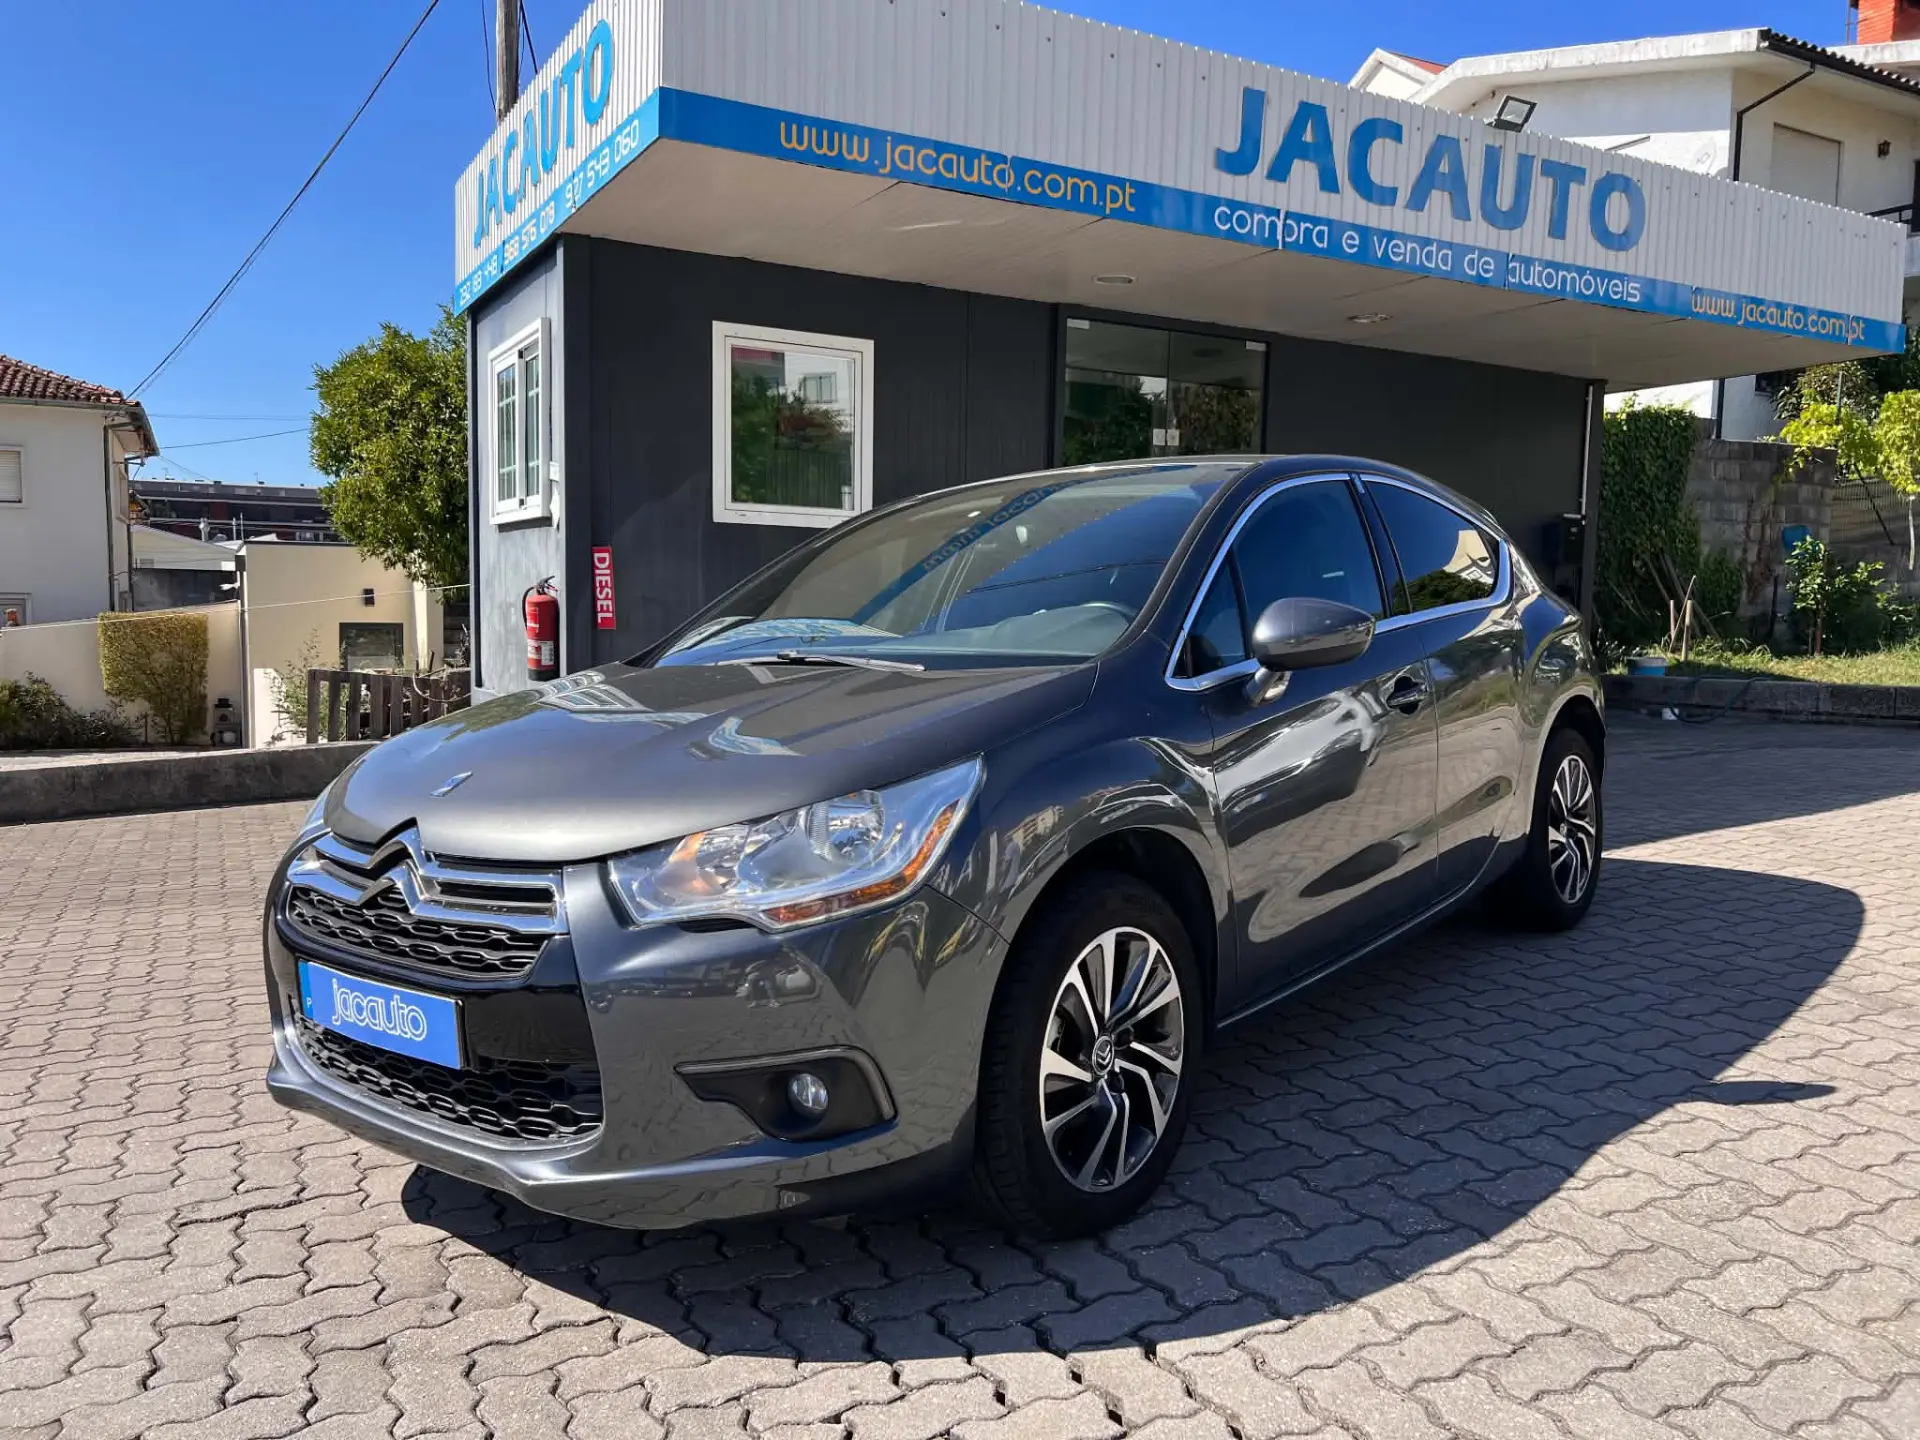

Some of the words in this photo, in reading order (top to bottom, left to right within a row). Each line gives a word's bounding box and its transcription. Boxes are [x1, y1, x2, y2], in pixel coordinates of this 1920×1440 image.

[474, 19, 613, 249] JACAUTO
[587, 147, 610, 188] 543
[614, 119, 639, 163] 060
[780, 121, 1136, 214] www.jacauto.com.pt
[1215, 87, 1645, 251] JACAUTO
[1214, 205, 1328, 248] compra
[1341, 232, 1360, 254] e
[1374, 236, 1452, 271] venda
[1464, 248, 1495, 278] de
[1508, 257, 1641, 302] automóveis
[593, 552, 613, 623] DIESEL
[331, 978, 427, 1041] jacauto
